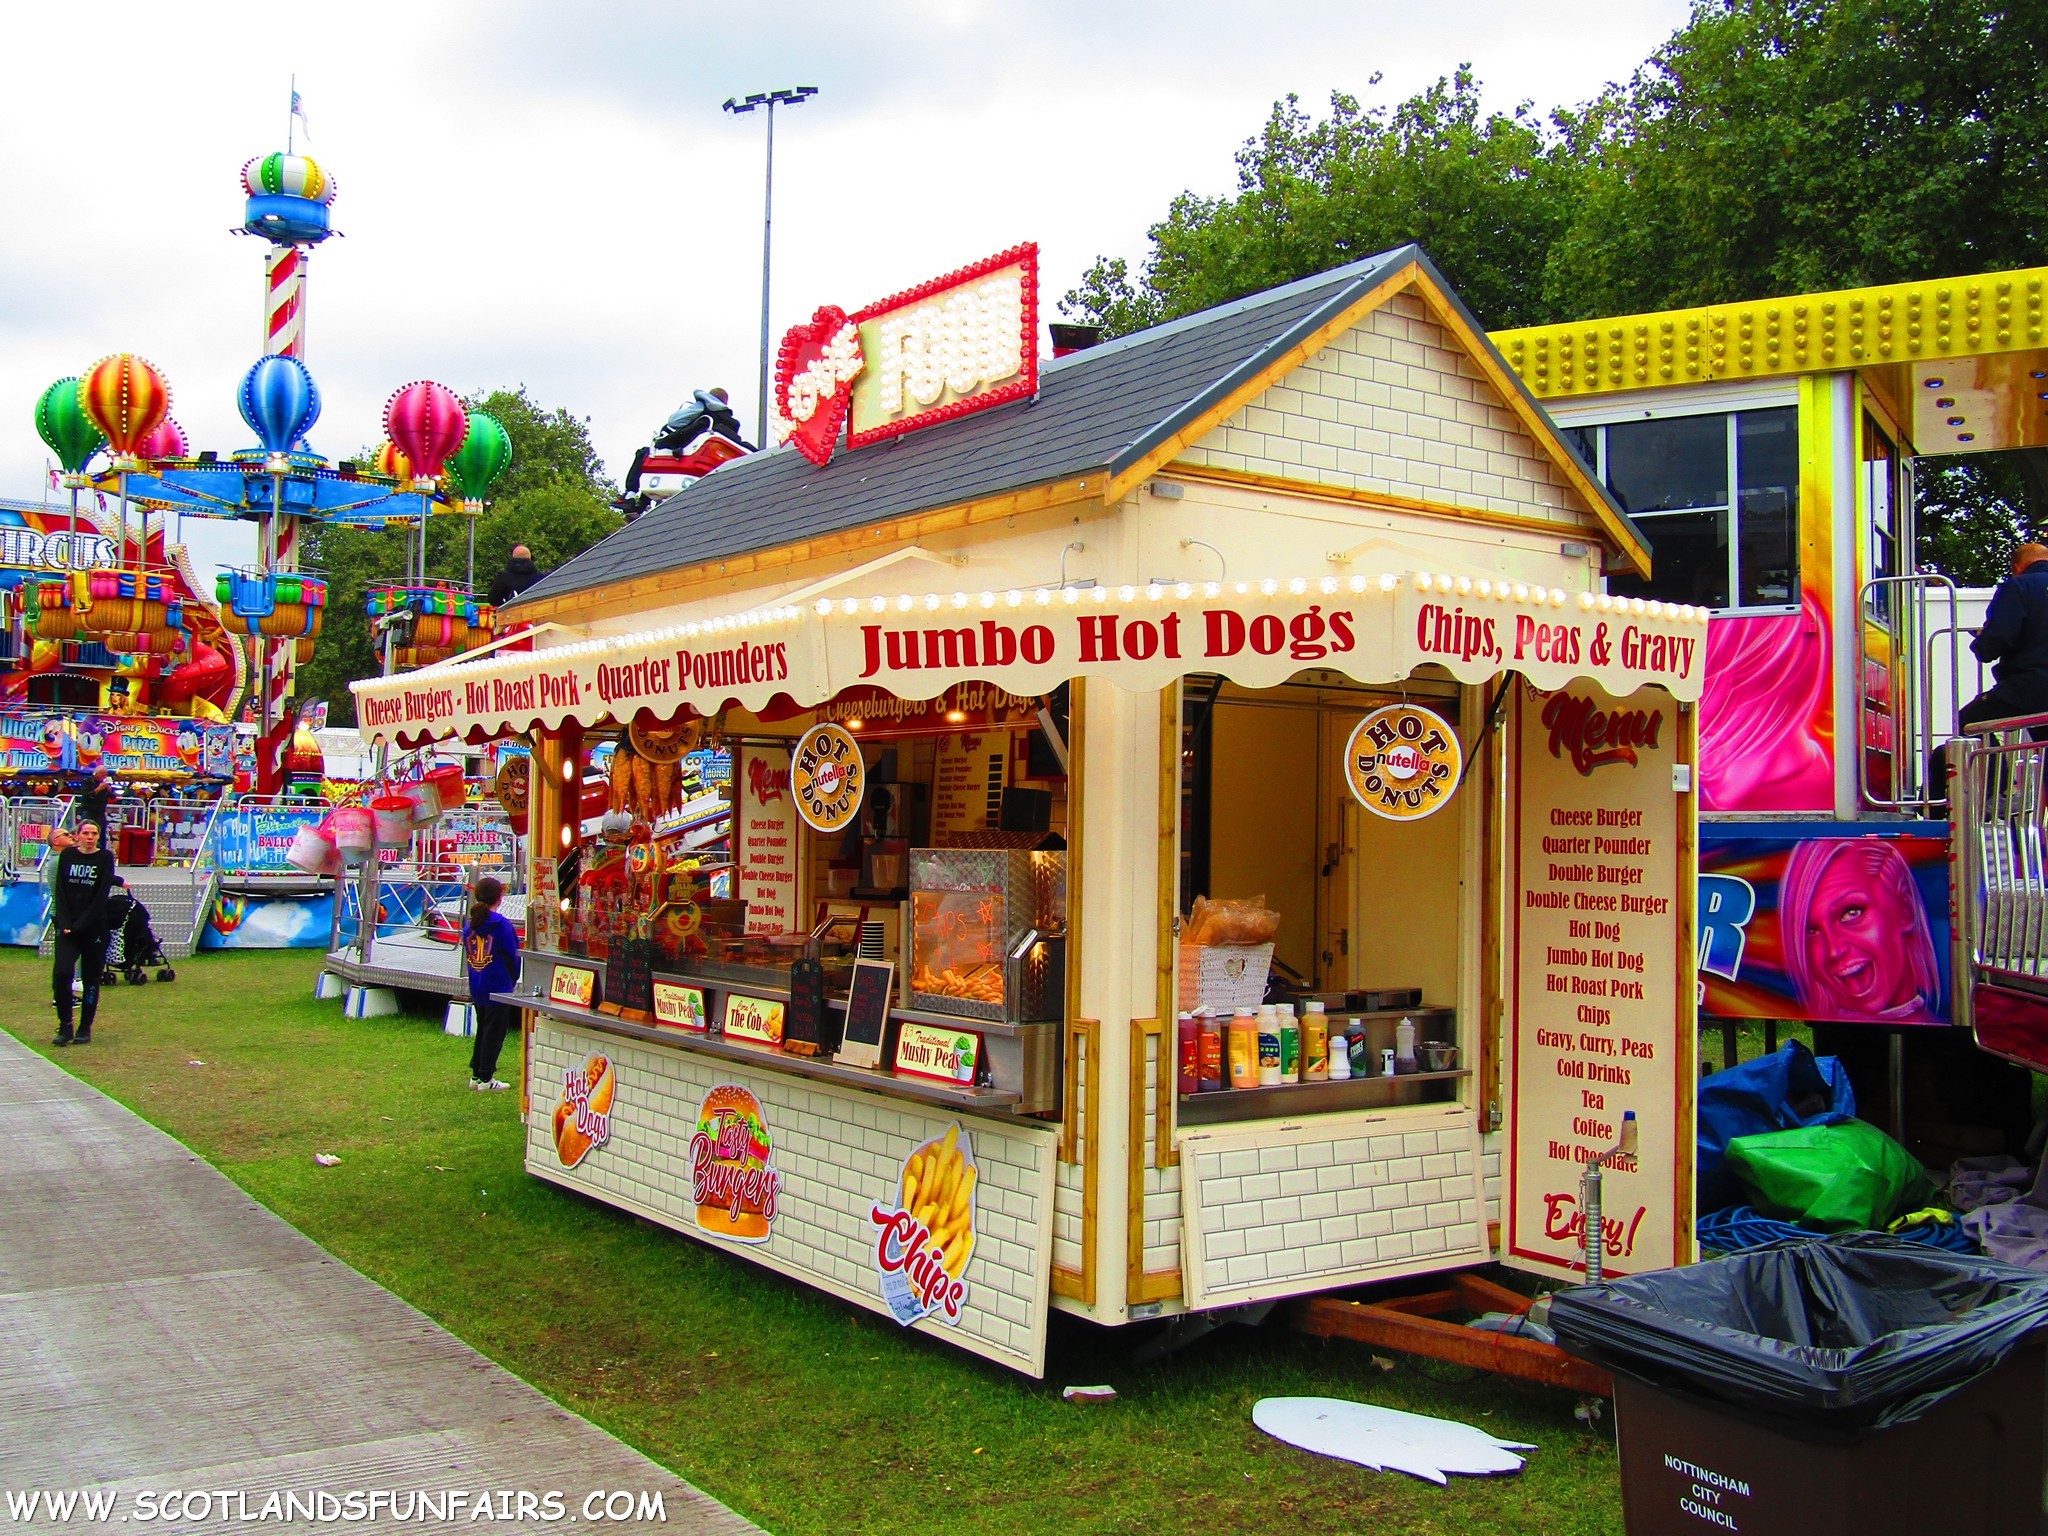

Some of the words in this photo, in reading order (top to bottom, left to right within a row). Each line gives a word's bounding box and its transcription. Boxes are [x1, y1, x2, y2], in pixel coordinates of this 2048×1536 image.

[0, 528, 115, 571] IRCUS
[859, 619, 1056, 678] Jumbo
[1077, 611, 1182, 663] Hot
[1203, 604, 1356, 661] Dogs
[1417, 602, 1502, 665] Chips,
[1514, 613, 1582, 665] Peas
[1590, 621, 1612, 667] &
[1621, 624, 1695, 680] Gravy
[365, 696, 403, 727] Cheese
[405, 686, 454, 723] Burgers
[466, 680, 492, 715] Hot
[494, 675, 535, 713] Roast
[539, 669, 581, 709] Pork
[597, 656, 671, 703] Quarter
[677, 640, 788, 691] Pounders
[935, 694, 948, 714] &
[955, 681, 986, 712] Hot
[1, 718, 47, 743] Duck
[1364, 715, 1448, 756] HOT
[1541, 691, 1664, 777] Menu
[122, 735, 159, 752] Prize
[799, 733, 850, 778] HOT
[9, 750, 49, 768] Time
[103, 752, 141, 770] Every
[143, 754, 180, 770] Time
[505, 763, 528, 779] HO
[1376, 752, 1431, 772] nutella
[812, 763, 846, 789] nutella
[1358, 754, 1450, 808] DONUTS
[502, 782, 527, 809] DONU
[801, 762, 858, 822] DONUTS
[750, 819, 767, 830] Cheese
[767, 819, 784, 831] Burger
[1550, 808, 1593, 826] Cheese
[1596, 808, 1643, 828] Burger
[258, 836, 295, 847] BALLO
[454, 833, 498, 843] FAIR
[1542, 835, 1591, 854] Quarter
[1594, 836, 1651, 855] Pounder
[448, 854, 476, 864] THE
[480, 854, 503, 864] AIR
[767, 853, 784, 865] Burger
[776, 871, 793, 883] Burger
[1548, 863, 1593, 882] Double
[1597, 864, 1643, 885] Burger
[757, 887, 765, 898] Hot
[766, 887, 776, 900] Dog
[1526, 890, 1570, 909] Double
[1573, 892, 1617, 912] Cheese
[1620, 893, 1668, 915] Burger
[1569, 920, 1591, 938] Hot
[1594, 921, 1620, 942] Dog
[1546, 946, 1587, 967] Jumbo
[1591, 949, 1614, 968] Hot
[1617, 950, 1644, 973] Dog
[555, 977, 566, 993] The
[566, 979, 577, 995] Cob
[1546, 973, 1568, 992] Hot
[1571, 975, 1607, 996] Roast
[1610, 981, 1644, 1000] Pork
[657, 998, 676, 1018] Mushy
[730, 1008, 744, 1028] The
[746, 1010, 762, 1031] Cob
[1577, 1004, 1611, 1026] Chips
[915, 1030, 951, 1048] Traditional
[1537, 1028, 1576, 1052] Gravy,
[1580, 1033, 1617, 1057] Curry,
[1621, 1037, 1654, 1060] Peas
[900, 1041, 932, 1067] Mushy
[933, 1047, 961, 1071] Peas
[565, 1070, 588, 1099] Hot
[1557, 1058, 1584, 1079] Cold
[1587, 1062, 1631, 1086] Drinks
[1582, 1089, 1604, 1110] Tea
[576, 1097, 608, 1144] Dogs
[1573, 1116, 1613, 1140] Coffee
[713, 1107, 752, 1165] Tasty
[1548, 1140, 1570, 1161] Hot
[690, 1133, 779, 1222] Burgers
[871, 1205, 964, 1317] Chips
[1664, 1453, 1750, 1496] NOTTINGHAM
[1692, 1483, 1720, 1505] CITY
[1680, 1497, 1738, 1530] COUNCIL
